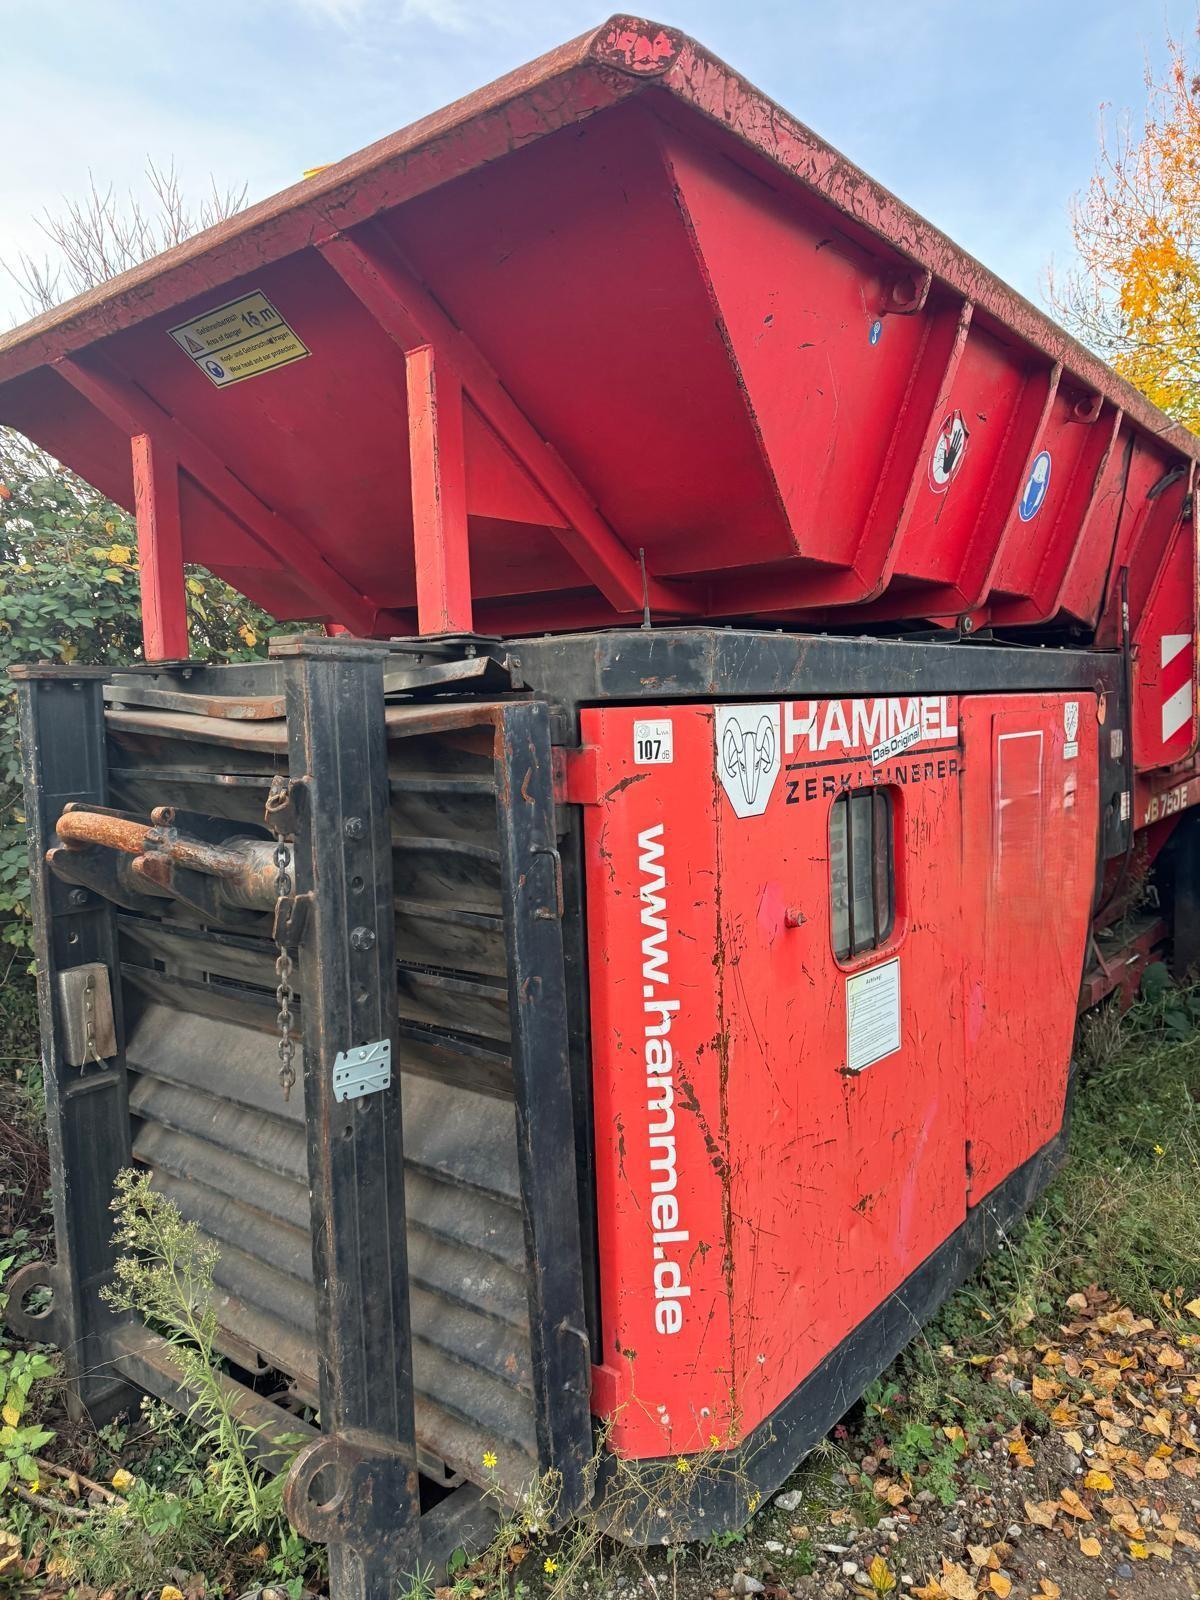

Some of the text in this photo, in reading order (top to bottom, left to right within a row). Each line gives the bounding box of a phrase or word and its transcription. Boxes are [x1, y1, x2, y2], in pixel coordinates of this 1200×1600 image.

[259, 308, 275, 321] m
[206, 336, 219, 346] Area
[224, 328, 242, 340] danger
[272, 331, 290, 341] tragen
[240, 360, 254, 369] head
[253, 355, 264, 365] and
[271, 343, 298, 358] protection
[785, 696, 958, 754] HAMMEL
[637, 740, 670, 760] 107 dB
[872, 726, 920, 761] Das Original
[638, 823, 691, 1335] www.hammel.de
